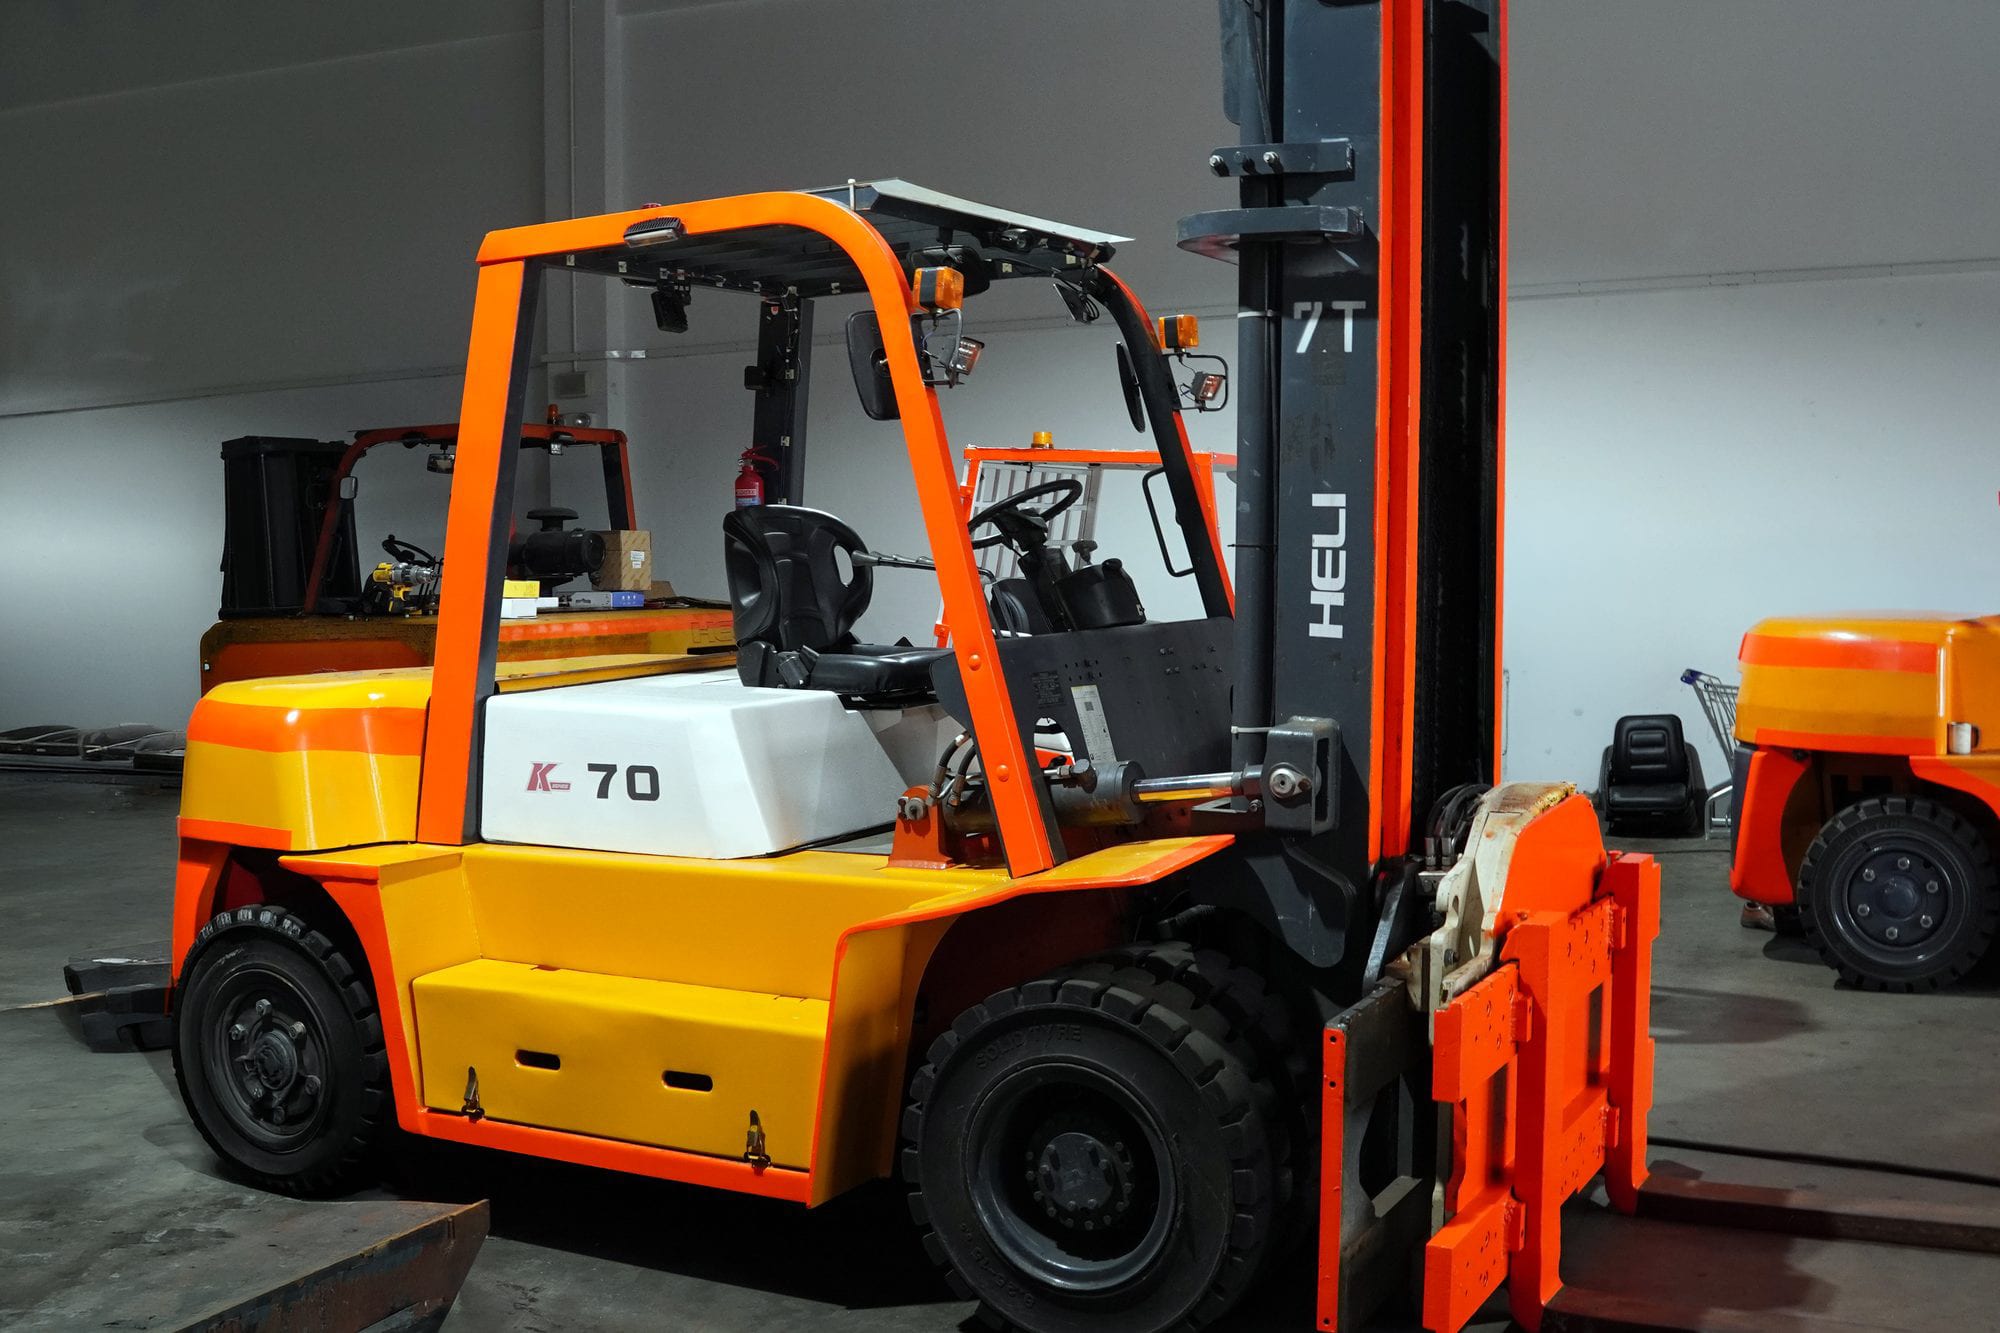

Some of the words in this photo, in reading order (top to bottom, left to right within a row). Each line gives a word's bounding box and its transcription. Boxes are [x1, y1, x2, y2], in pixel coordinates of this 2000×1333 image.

[1293, 301, 1367, 354] 7T
[1308, 493, 1347, 640] HELI
[527, 762, 558, 792] K
[587, 763, 661, 802] 70
[1028, 1024, 1081, 1042] TYRE
